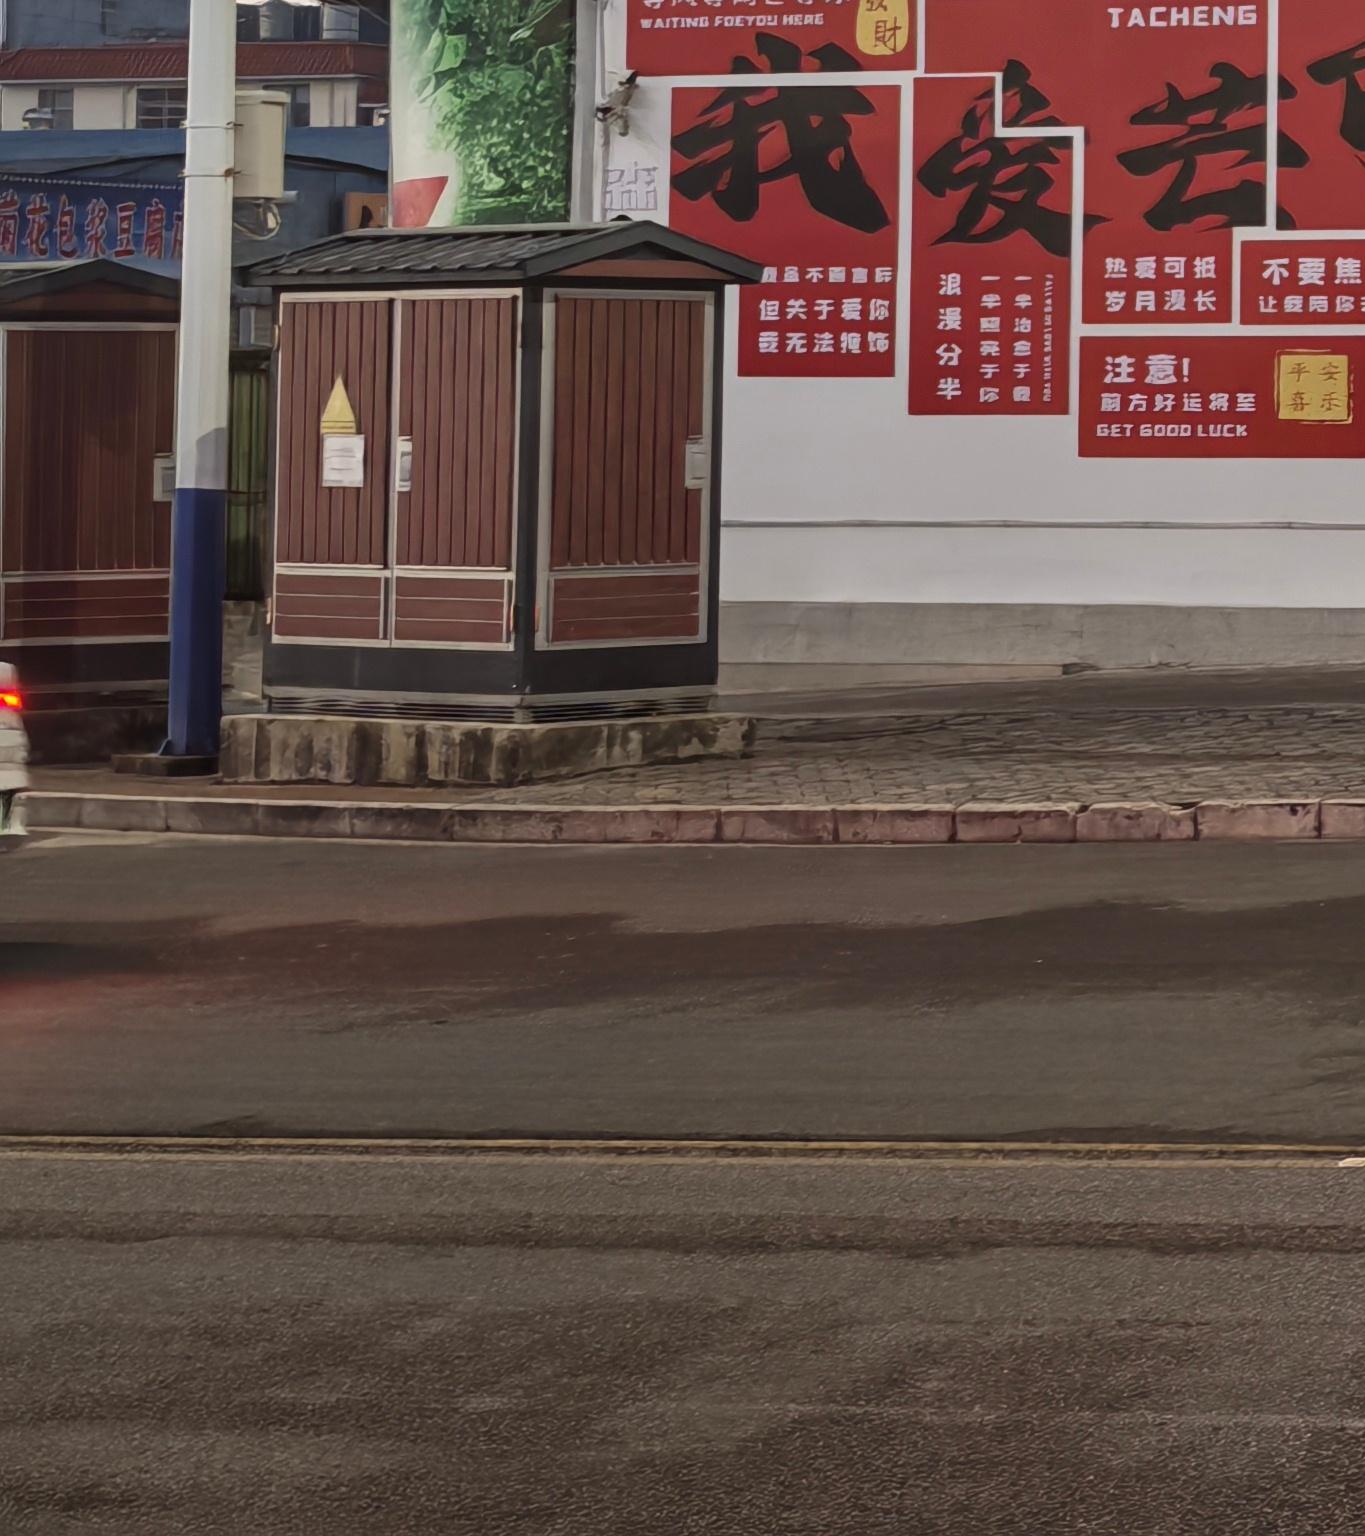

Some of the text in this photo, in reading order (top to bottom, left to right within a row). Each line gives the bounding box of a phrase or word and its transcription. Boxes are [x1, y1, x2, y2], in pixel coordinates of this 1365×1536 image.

[641, 16, 709, 29] WAITING
[1108, 5, 1257, 28] TACHENG
[759, 297, 890, 321] 但关于爱你
[1105, 289, 1217, 312] 岁月漫长
[1100, 392, 1256, 412] 前方好运将至
[1096, 423, 1248, 437] GET GOOD LUCK
